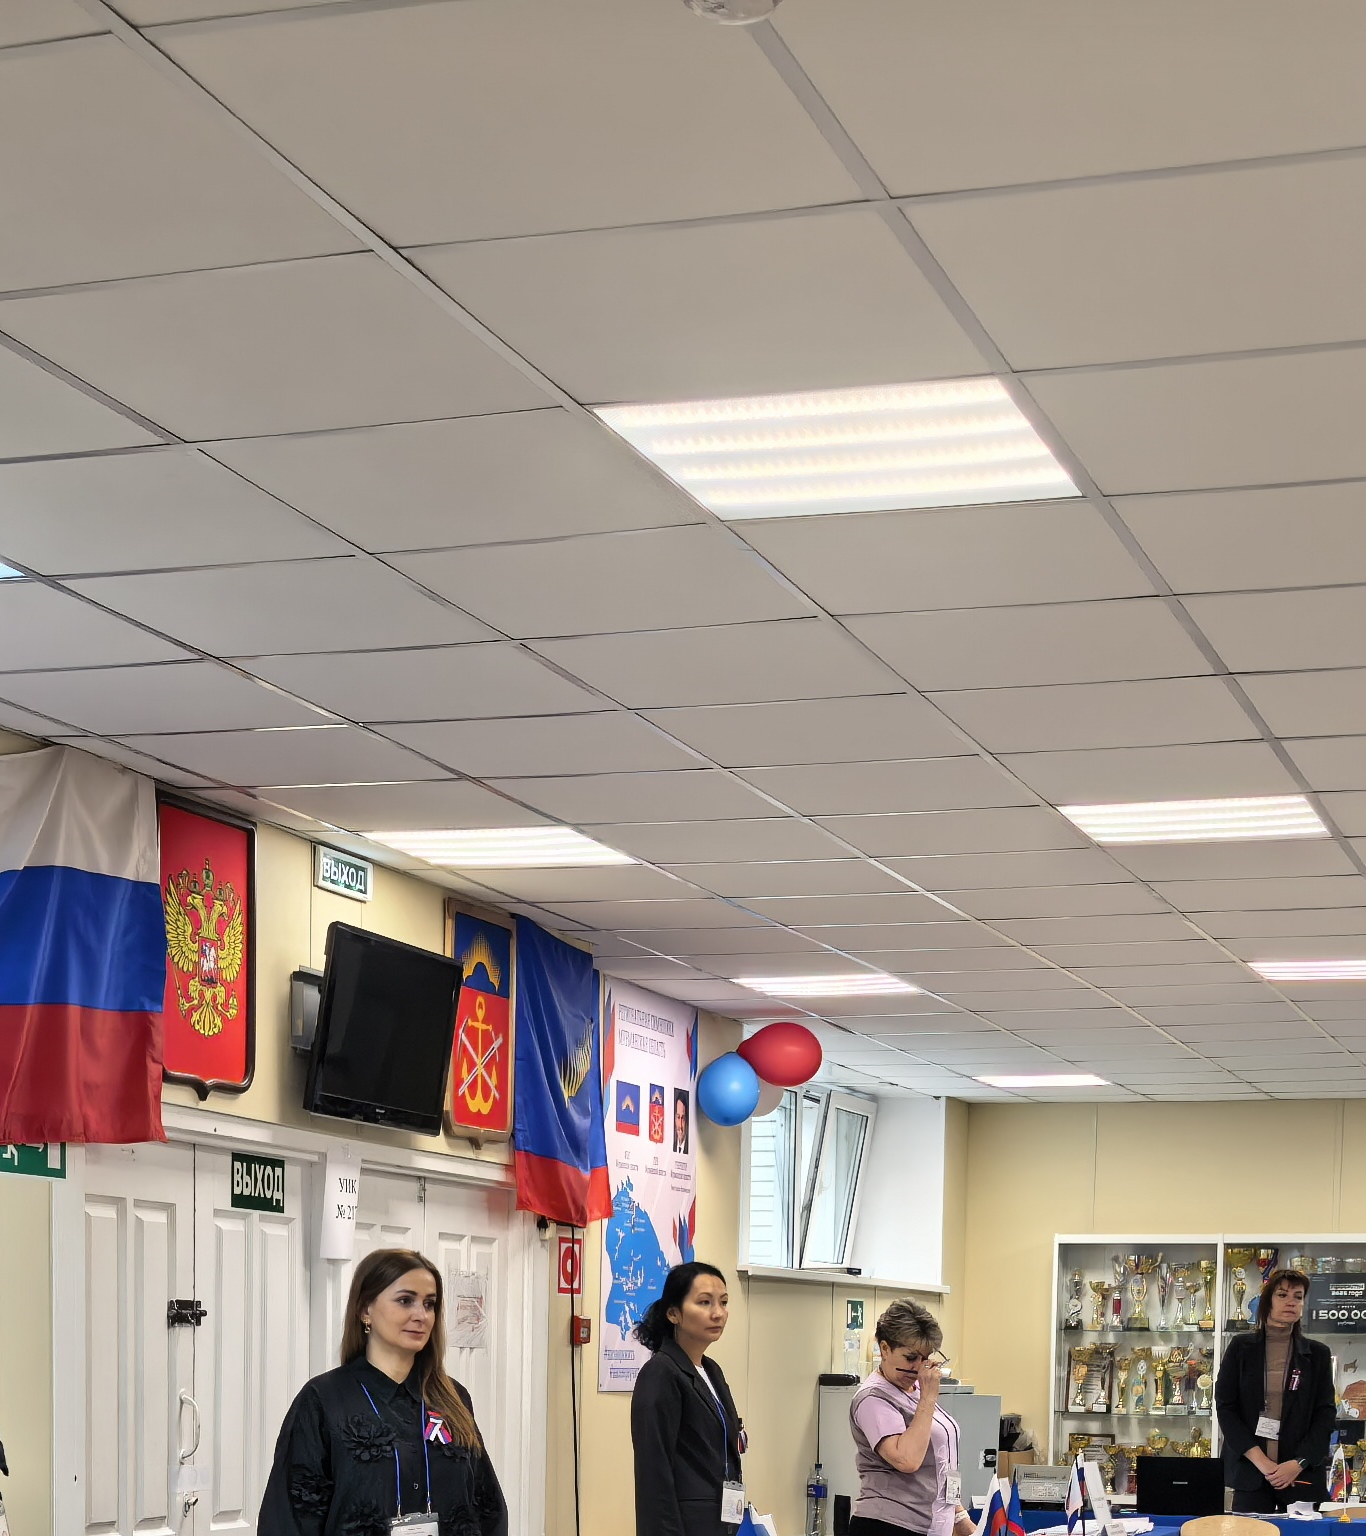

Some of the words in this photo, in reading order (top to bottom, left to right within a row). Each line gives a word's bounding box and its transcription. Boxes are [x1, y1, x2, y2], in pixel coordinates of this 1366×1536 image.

[322, 857, 365, 892] ВЫХОД
[233, 1161, 283, 1207] ВЫХОД
[338, 1177, 357, 1194] УИК
[335, 1204, 346, 1219] №
[1318, 1309, 1348, 1320] 500
